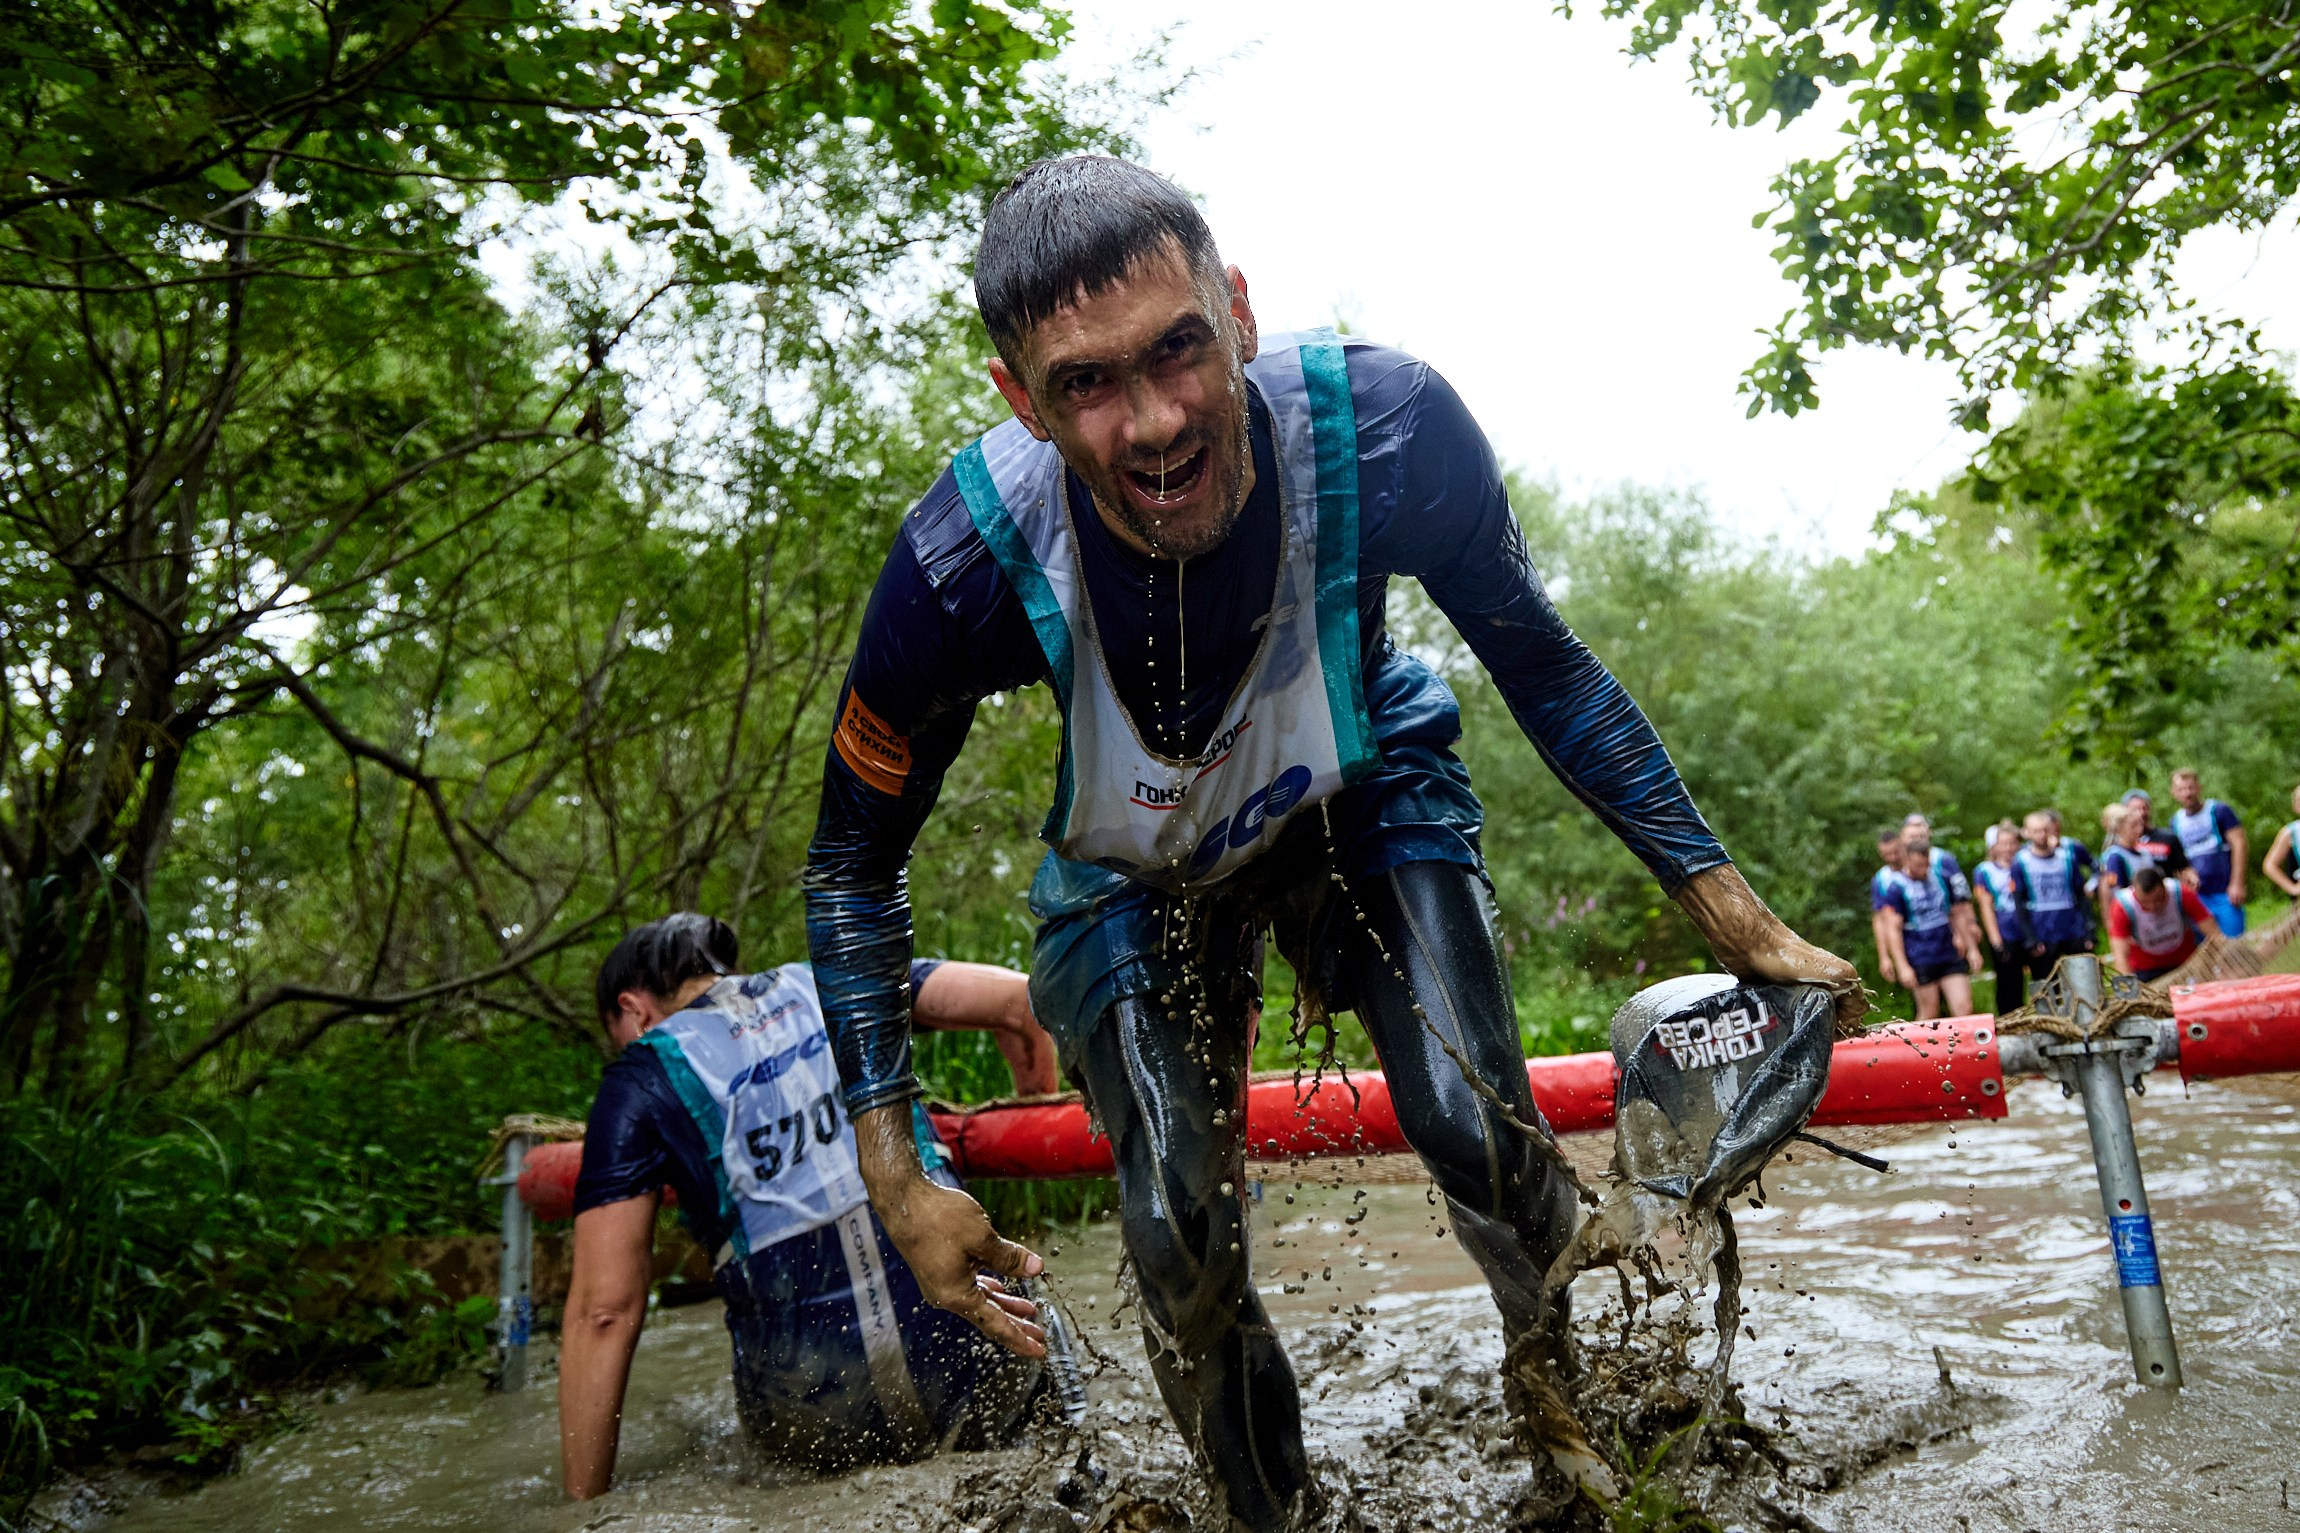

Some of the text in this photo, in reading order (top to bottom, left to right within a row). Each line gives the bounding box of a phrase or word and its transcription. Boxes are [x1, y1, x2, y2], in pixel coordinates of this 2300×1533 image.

[847, 718, 904, 763] СТИХИИ
[1135, 780, 1188, 804] ГОНК
[1670, 1030, 1765, 1072] ГОНКА
[744, 1092, 841, 1182] 570
[849, 1218, 884, 1330] COMPANY
